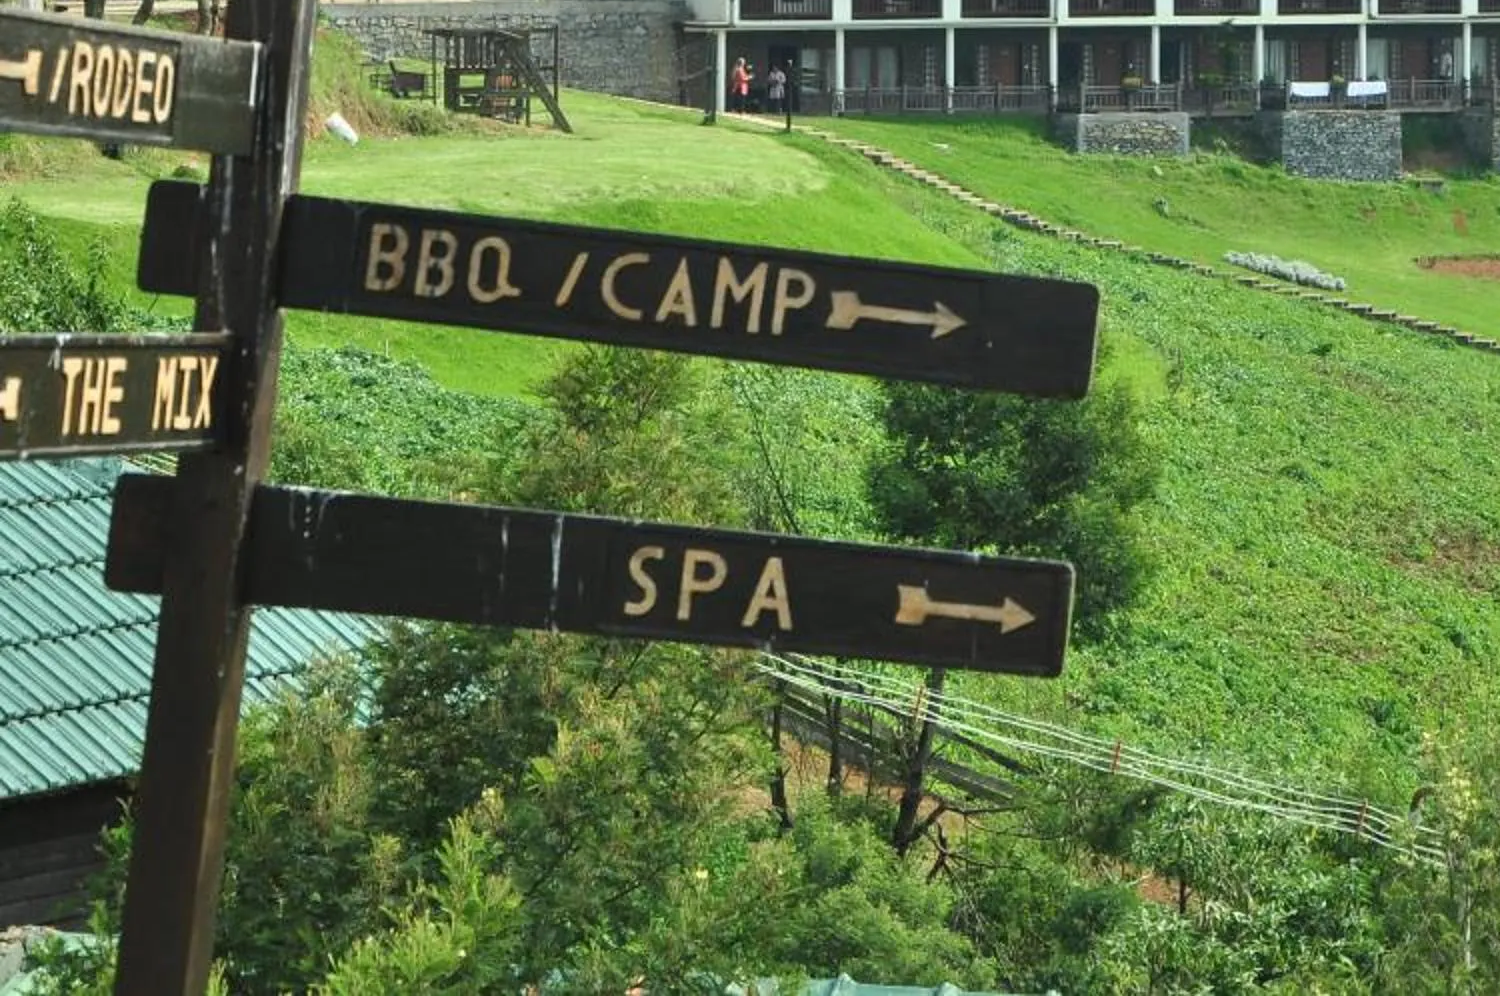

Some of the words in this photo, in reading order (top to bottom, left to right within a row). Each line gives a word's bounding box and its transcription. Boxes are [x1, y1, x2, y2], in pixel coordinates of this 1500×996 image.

[365, 222, 520, 303] BBQ
[61, 357, 128, 435] THE
[151, 356, 219, 431] MIX
[623, 546, 793, 631] SPA
